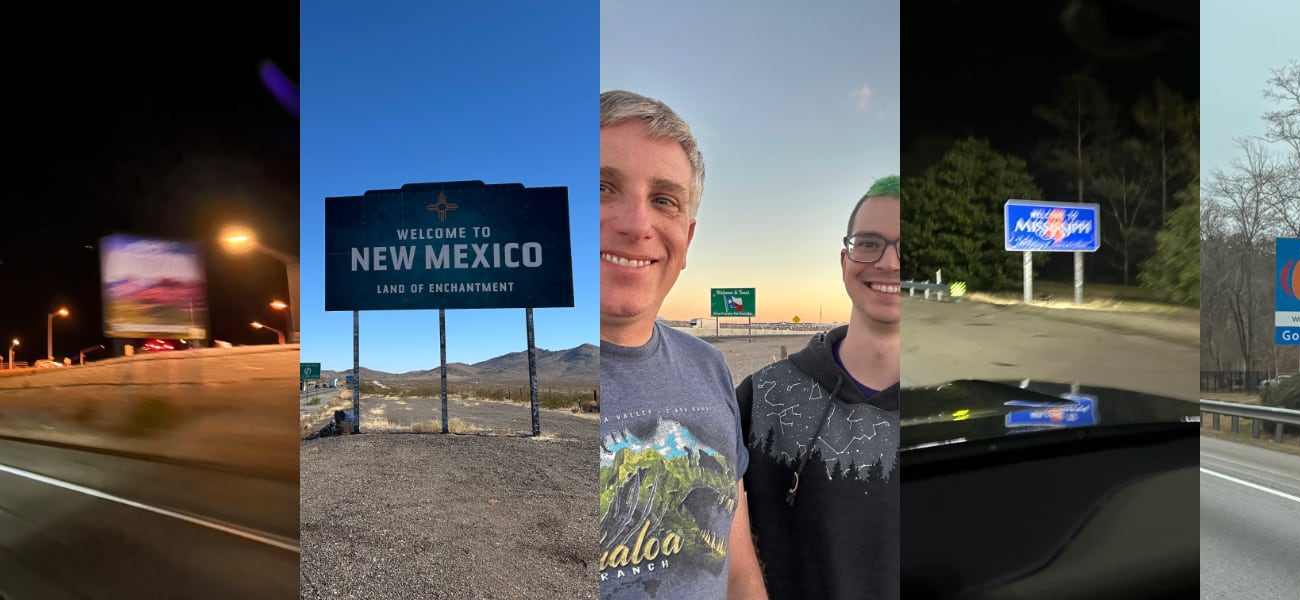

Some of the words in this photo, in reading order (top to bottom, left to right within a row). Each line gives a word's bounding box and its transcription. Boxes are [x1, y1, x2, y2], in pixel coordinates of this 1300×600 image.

[396, 227, 466, 240] WELCOME
[472, 226, 491, 238] TO
[351, 245, 417, 271] NEW
[425, 242, 543, 270] MEXICO
[377, 284, 405, 294] LAND
[410, 283, 424, 293] OF
[429, 282, 514, 293] ENCHANTMENT
[616, 409, 652, 420] VALLEY
[600, 519, 684, 571] ualoa
[600, 560, 669, 581] RANCH
